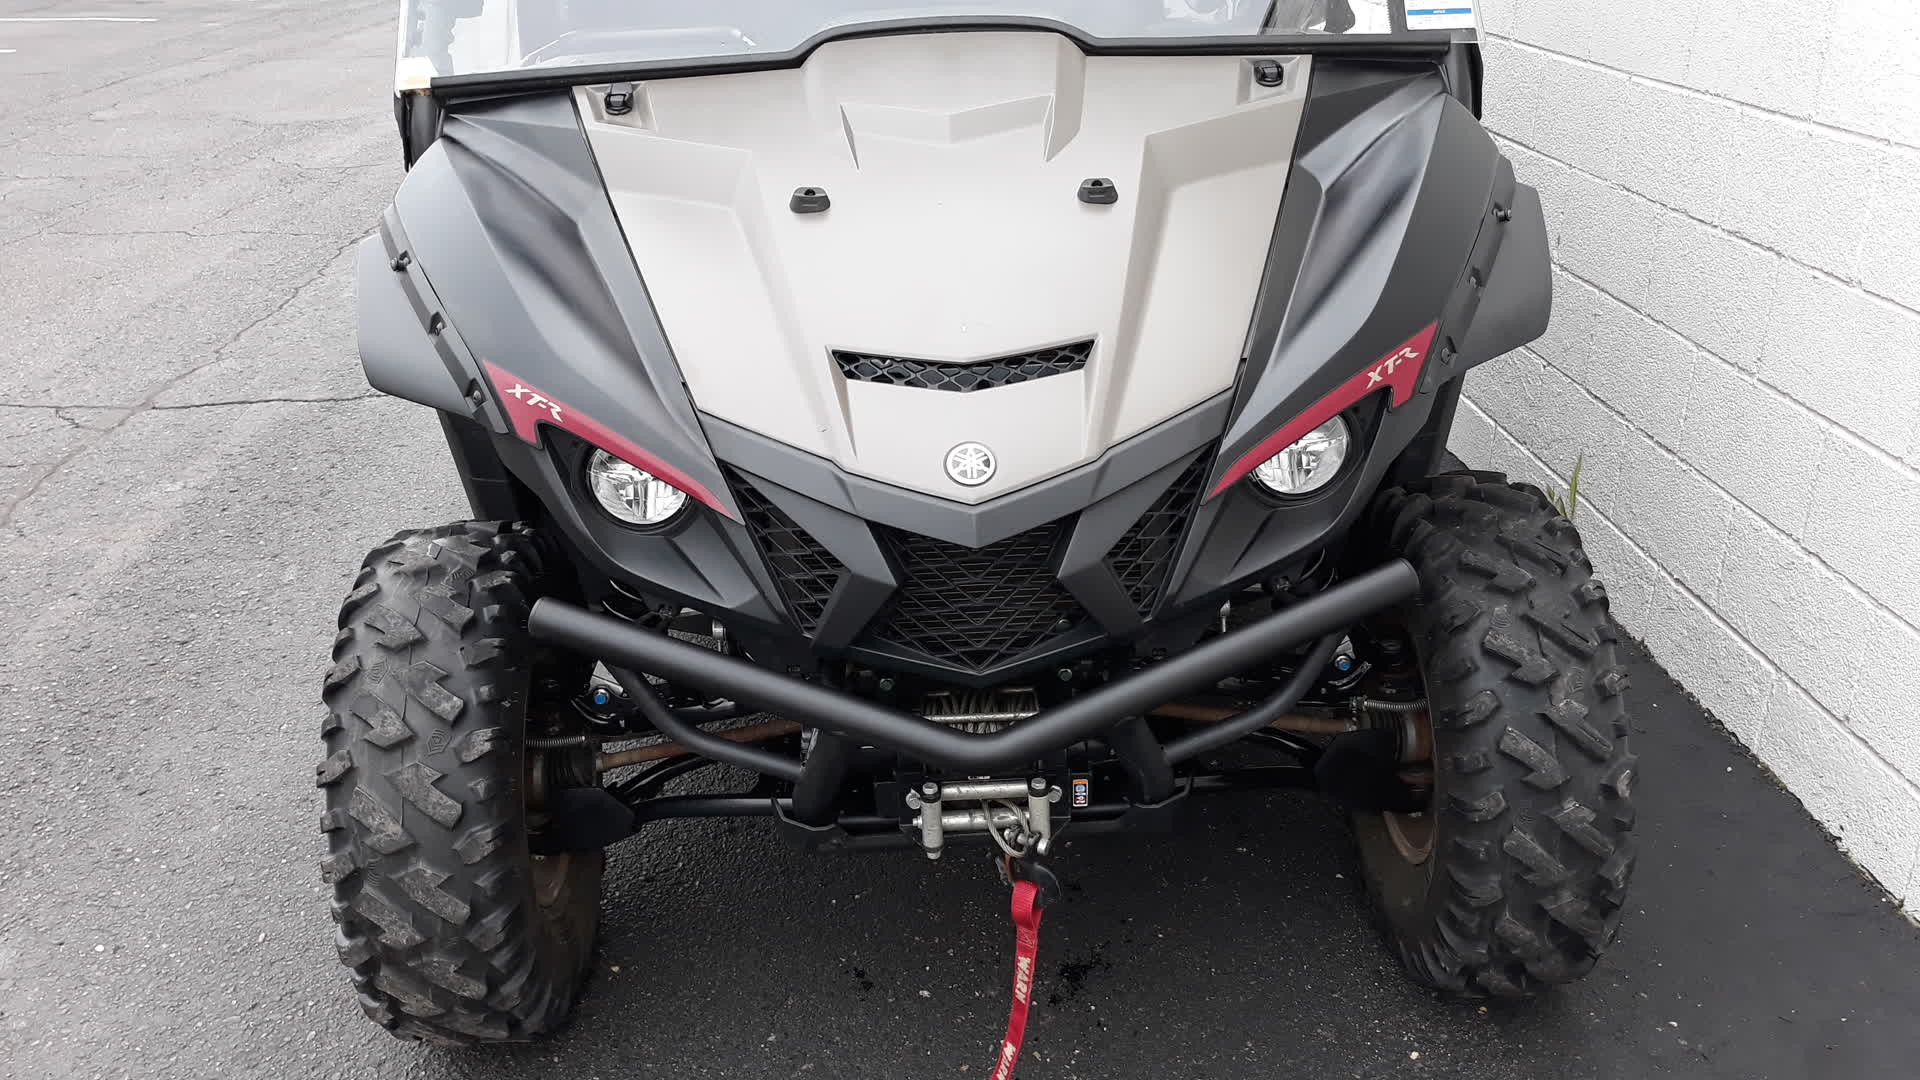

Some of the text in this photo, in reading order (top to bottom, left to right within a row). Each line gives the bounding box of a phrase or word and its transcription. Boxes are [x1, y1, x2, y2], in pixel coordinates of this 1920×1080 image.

[1366, 347, 1420, 390] XT-R
[504, 383, 563, 423] XT-R
[1015, 955, 1031, 1005] WARN
